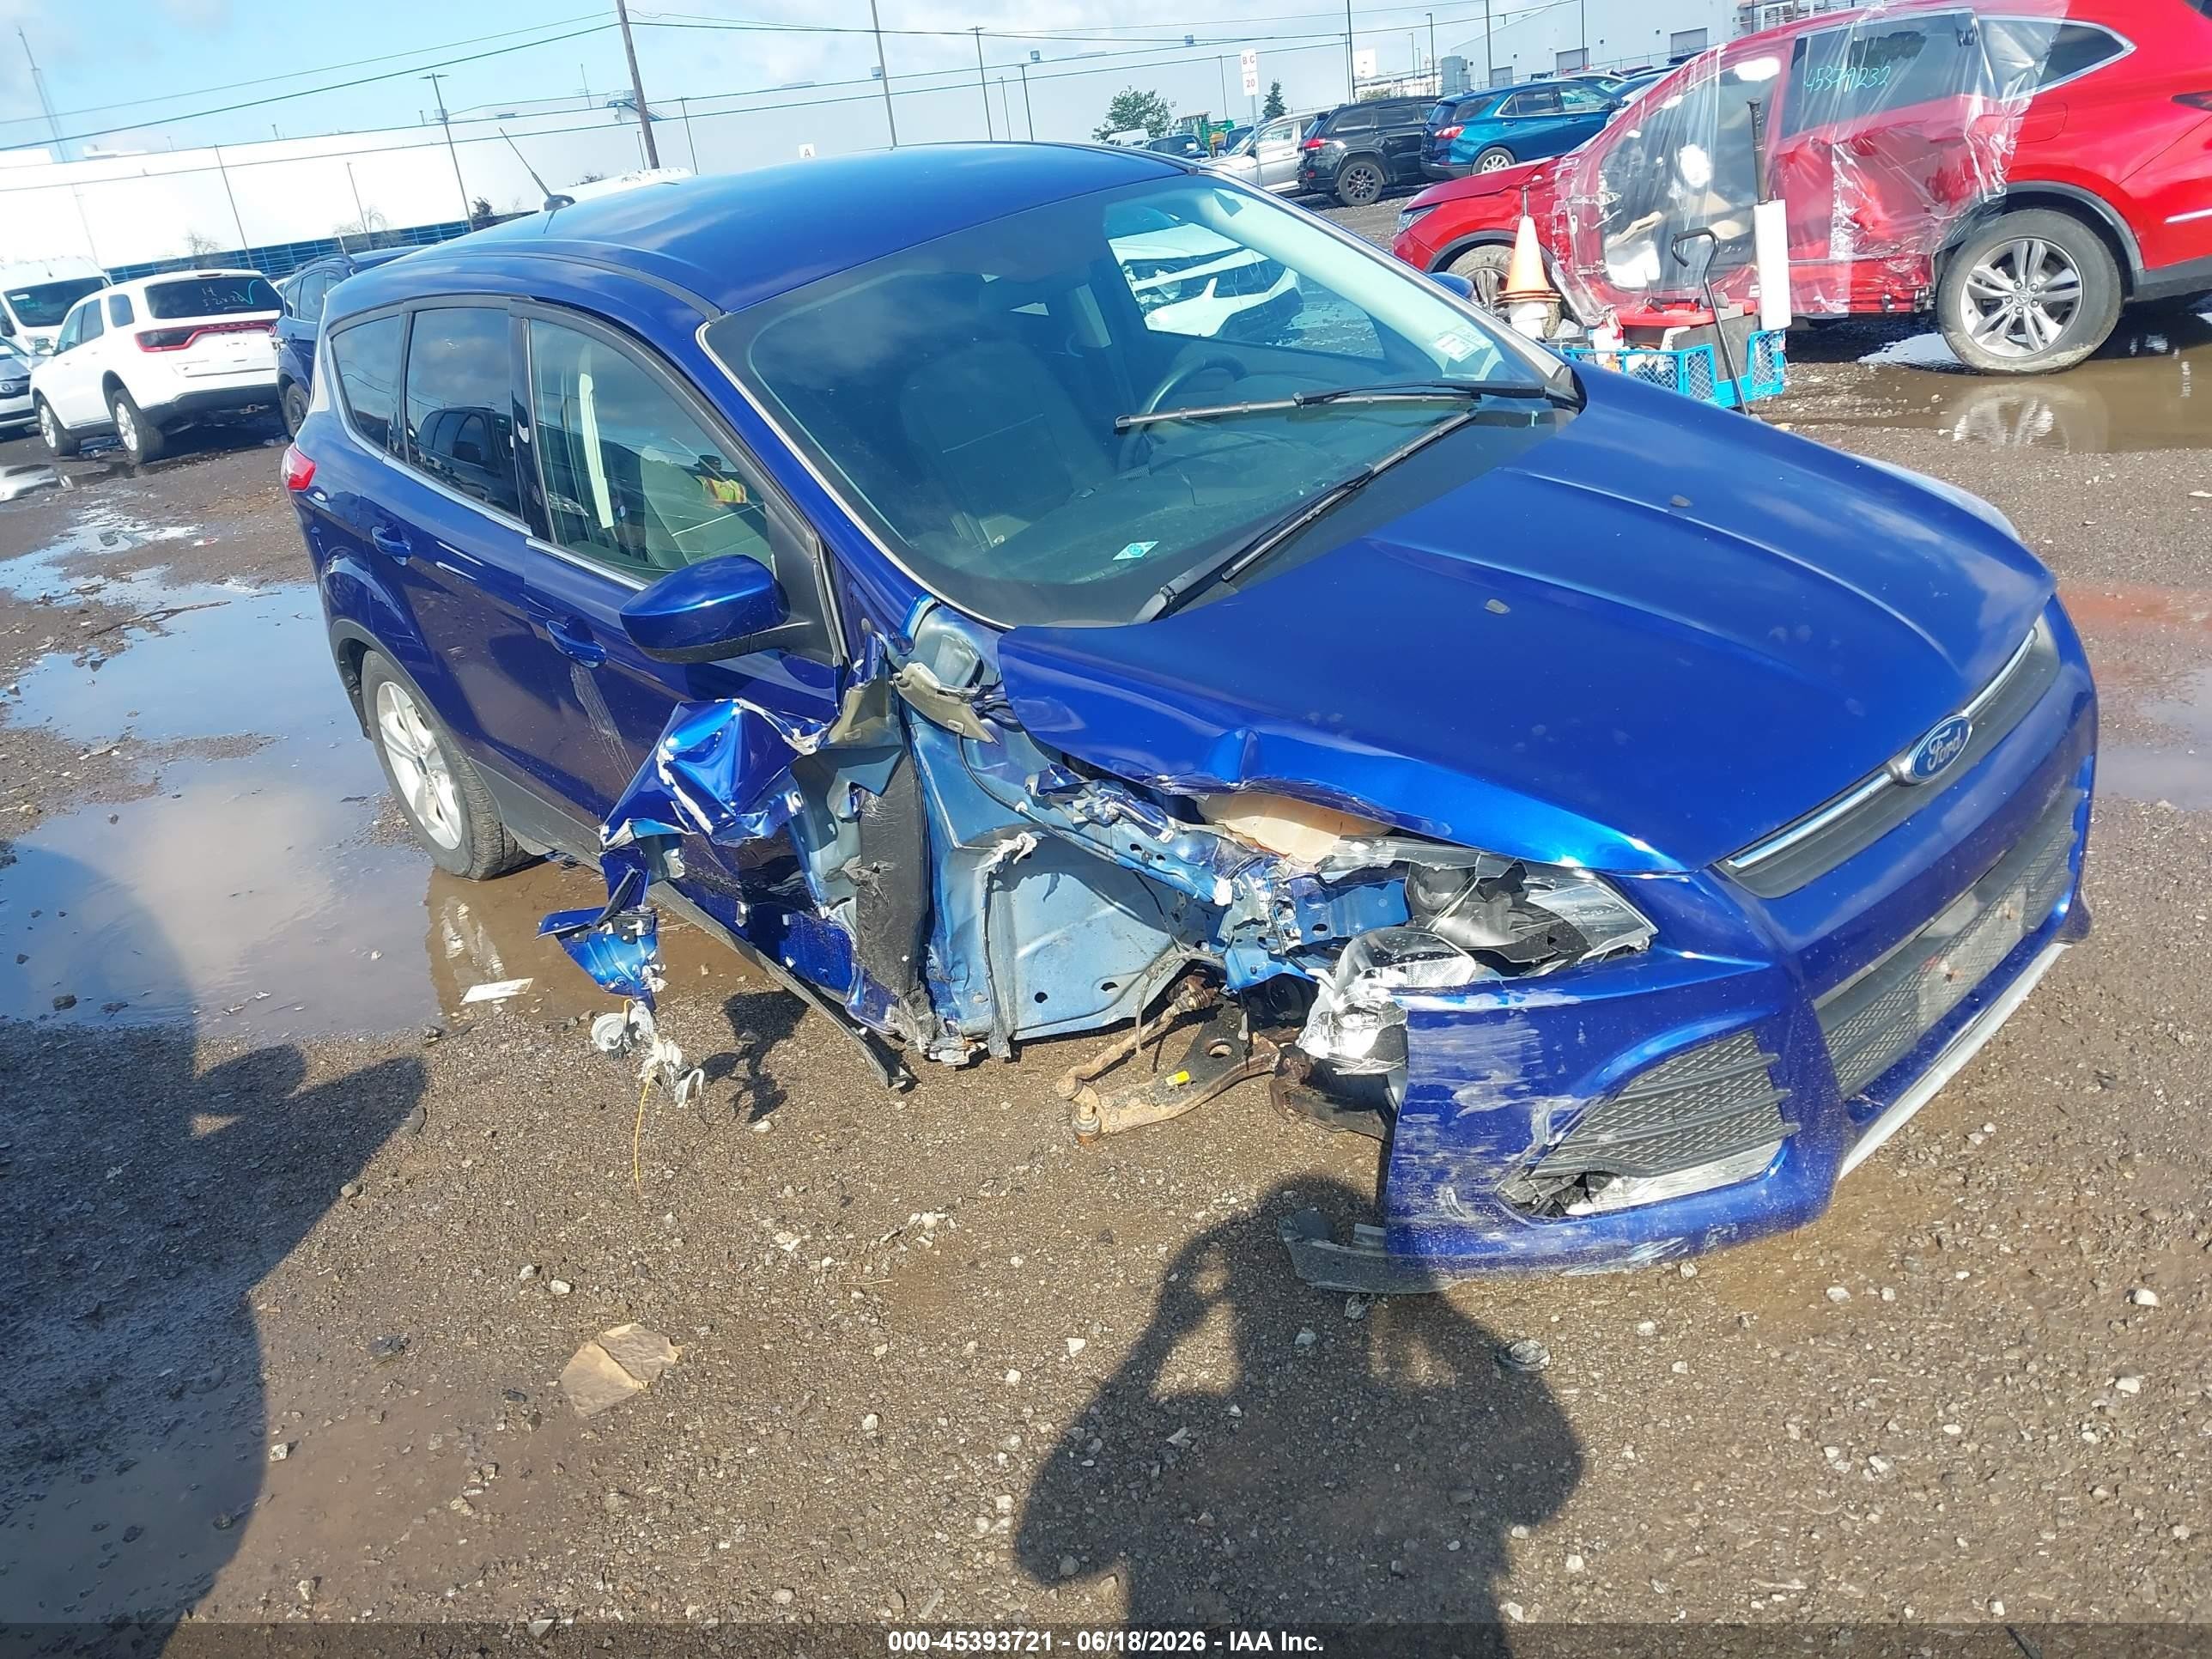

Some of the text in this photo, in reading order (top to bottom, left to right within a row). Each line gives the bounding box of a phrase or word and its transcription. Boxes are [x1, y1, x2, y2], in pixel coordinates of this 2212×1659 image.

[1245, 78, 1255, 88] 20
[804, 148, 811, 158] A
[1927, 726, 1963, 771] Ford
